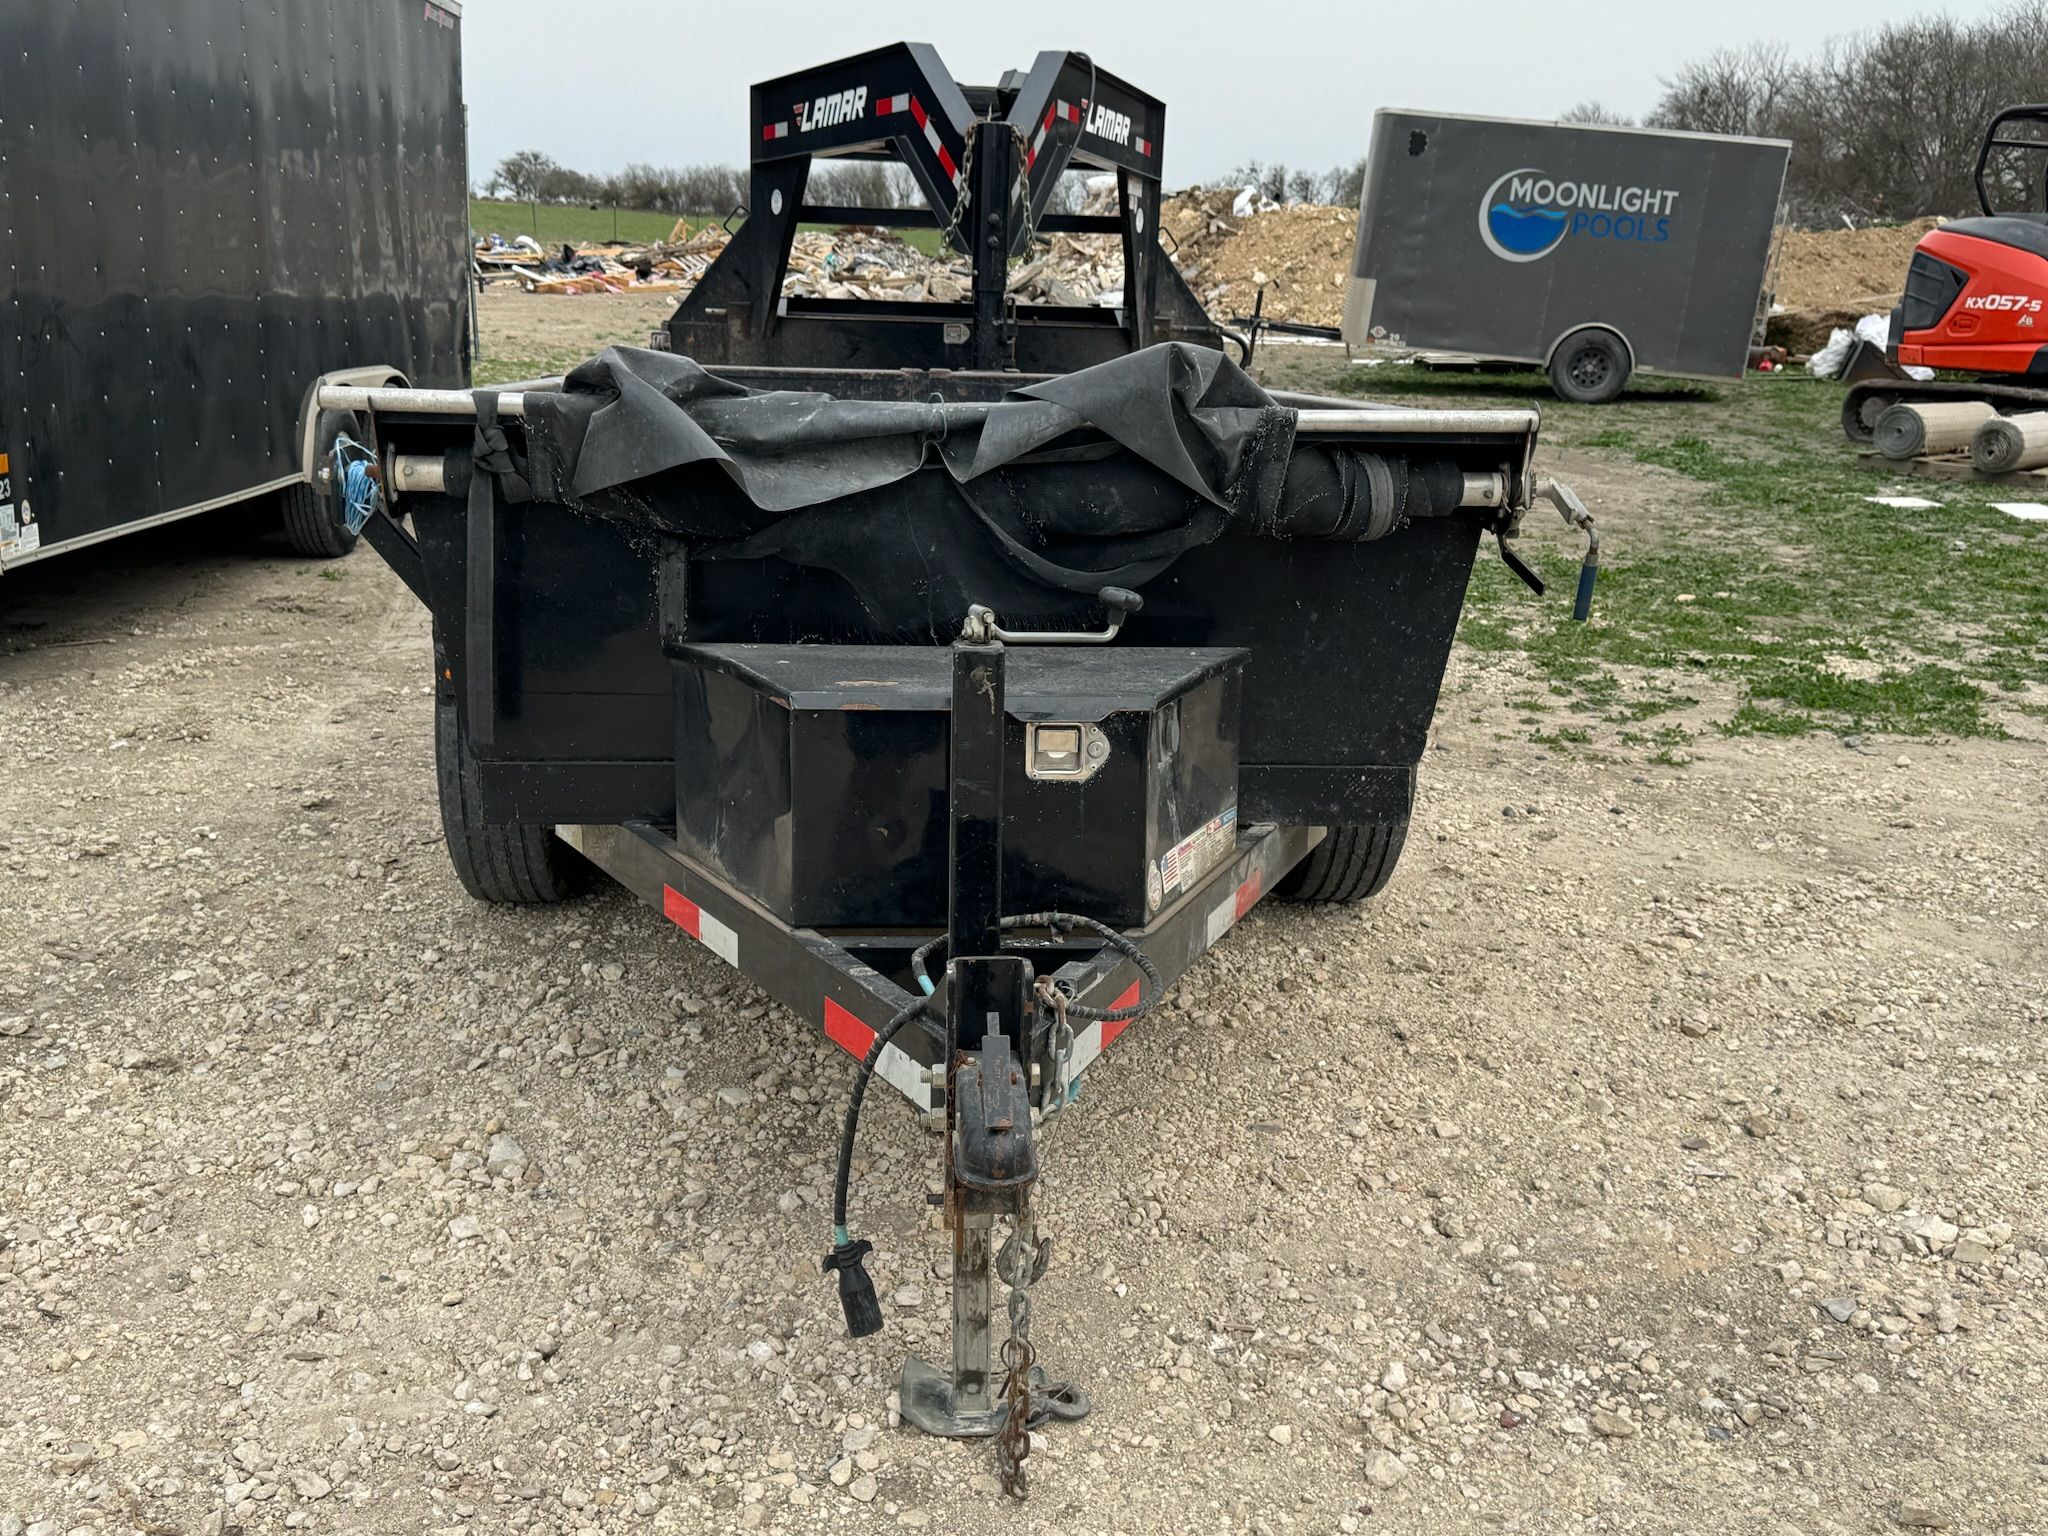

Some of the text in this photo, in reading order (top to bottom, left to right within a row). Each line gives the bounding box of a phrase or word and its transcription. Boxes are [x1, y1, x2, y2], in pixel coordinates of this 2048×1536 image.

[801, 86, 867, 132] LAMAR
[1086, 102, 1130, 146] LAMAR
[1510, 178, 1679, 215] MOONLIGHT
[1572, 212, 1669, 242] POOLS
[1965, 295, 2042, 311] KX057-5
